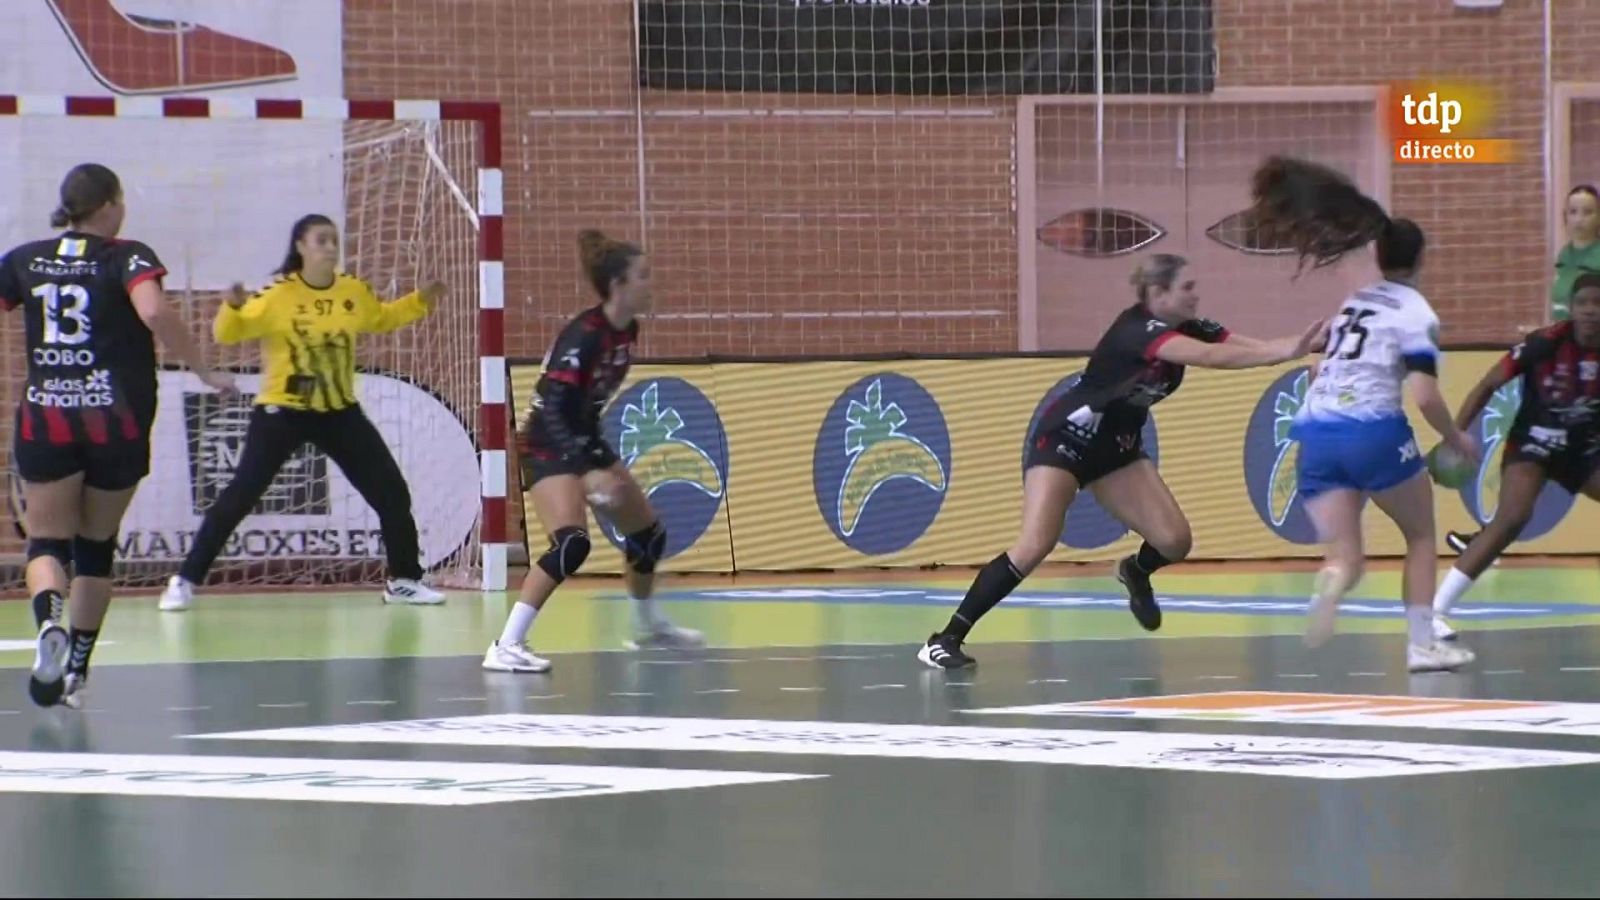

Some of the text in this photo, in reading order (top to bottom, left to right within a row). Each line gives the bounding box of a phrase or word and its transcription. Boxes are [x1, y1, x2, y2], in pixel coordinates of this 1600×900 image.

[31, 283, 91, 344] 13
[314, 299, 334, 316] 97
[33, 348, 94, 366] COBO
[27, 386, 114, 407] Canarias
